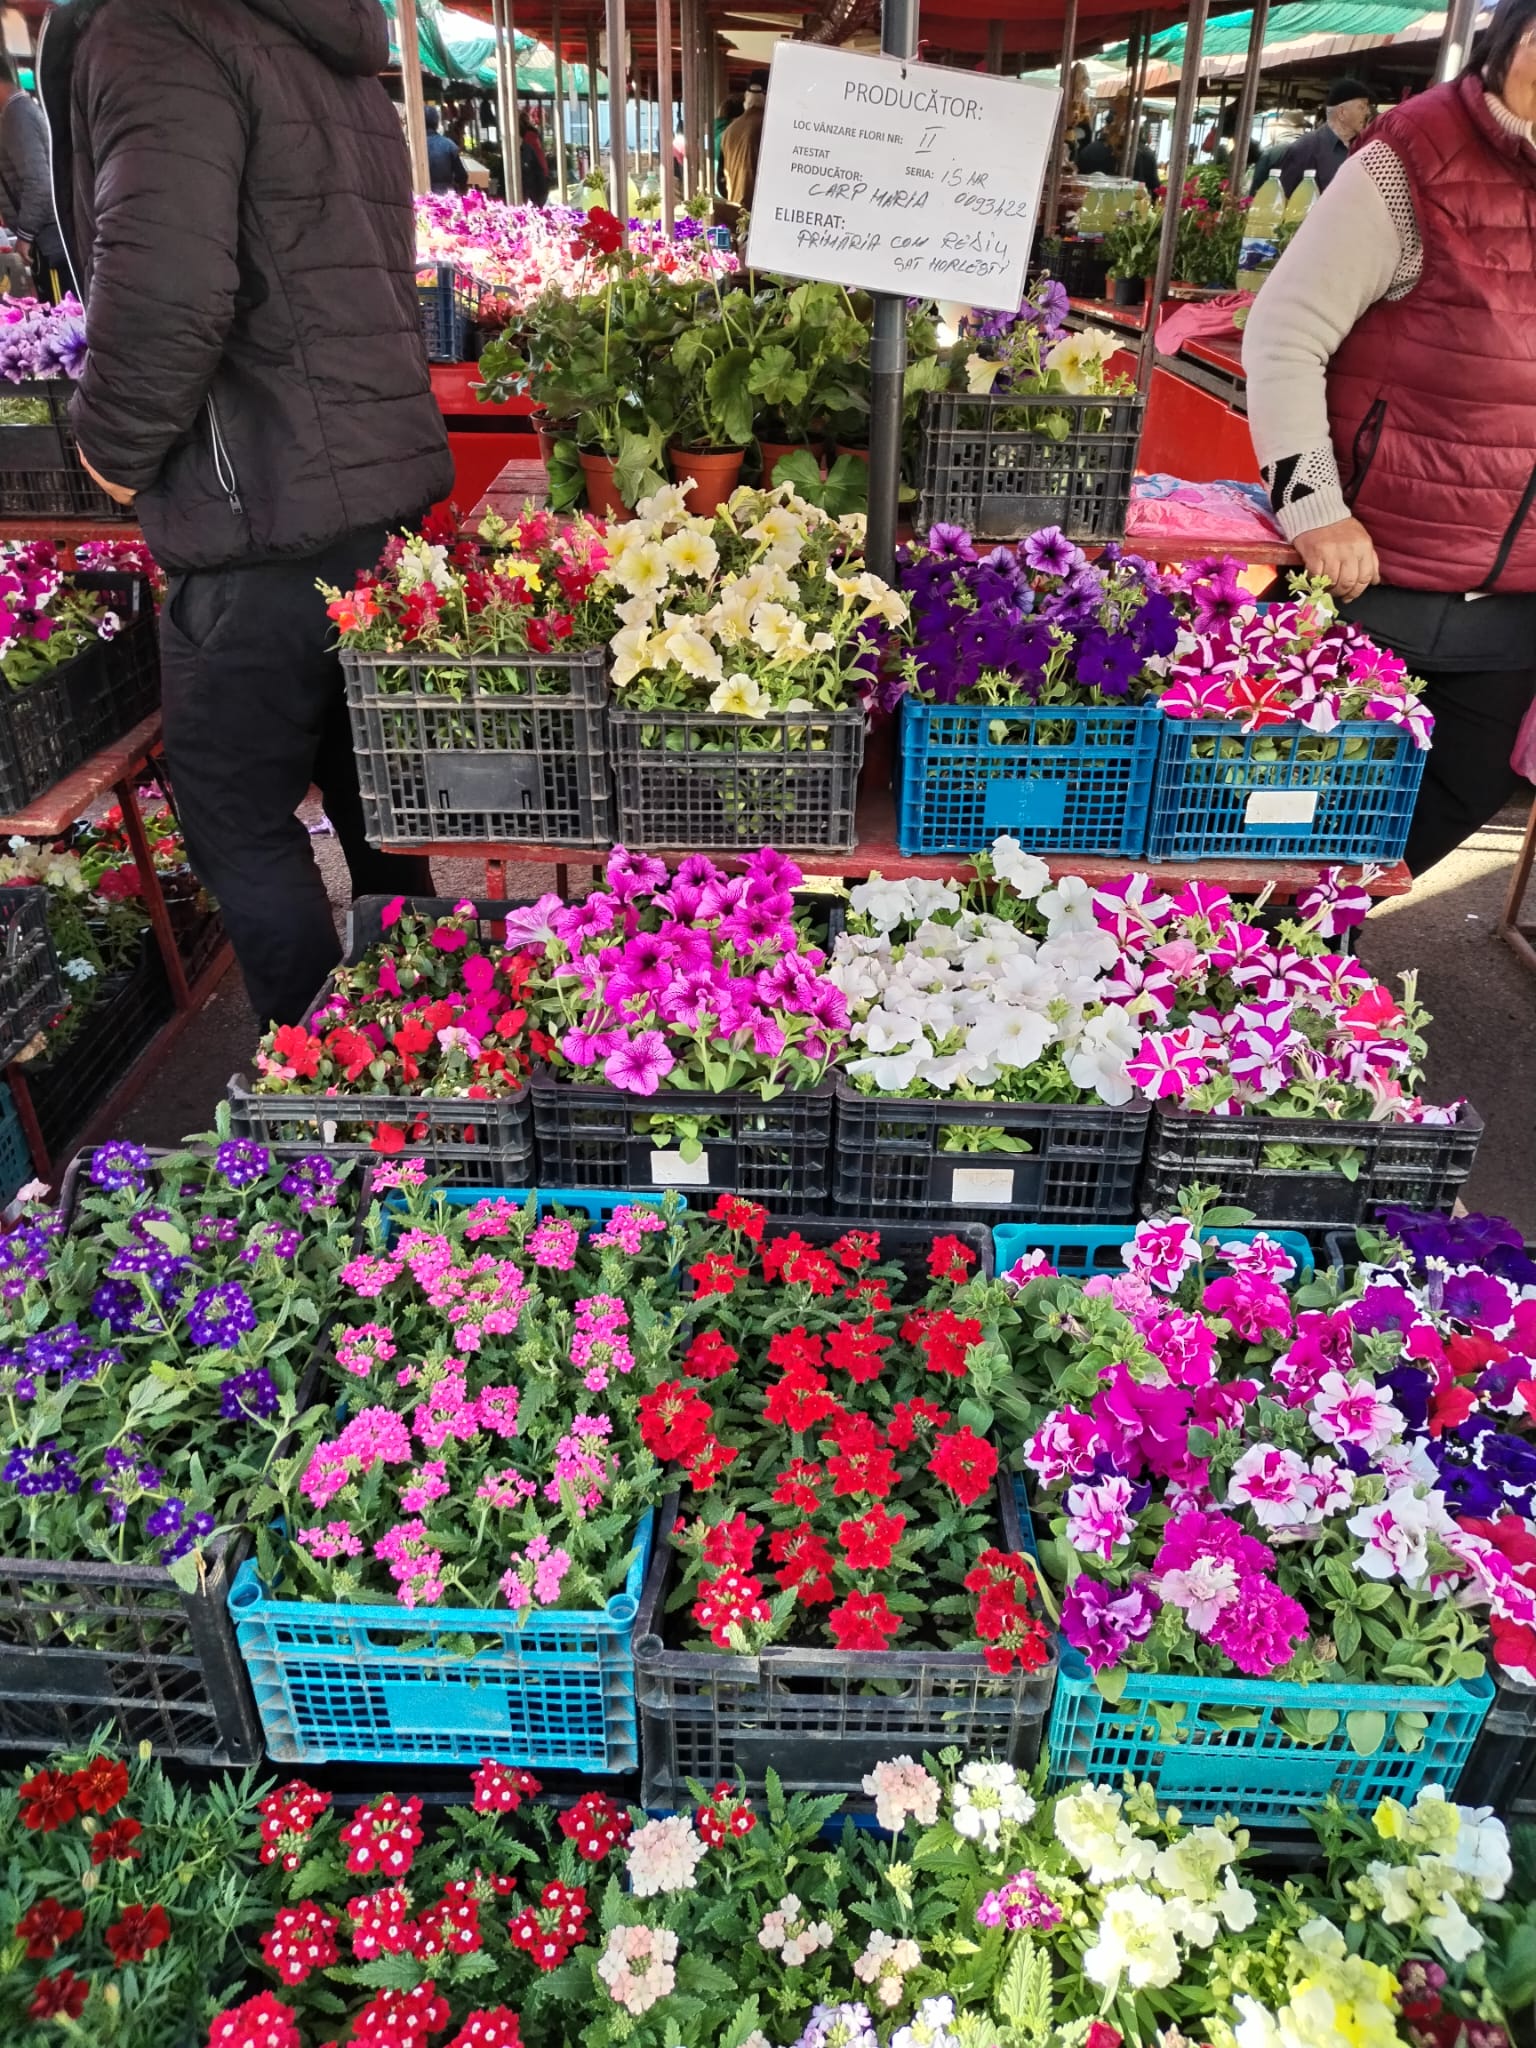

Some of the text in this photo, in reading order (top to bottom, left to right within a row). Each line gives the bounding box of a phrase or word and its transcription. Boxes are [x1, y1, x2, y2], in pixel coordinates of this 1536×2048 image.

[843, 80, 983, 121] PRODUCĂTOR:
[793, 119, 812, 131] LOC
[813, 121, 857, 138] VÂNZARE
[858, 129, 885, 142] FLORI
[887, 133, 904, 145] NR:
[792, 145, 831, 159] ATESTAT
[790, 162, 863, 181] PRODUCĂTOR:
[904, 166, 935, 180] SERIA:
[808, 182, 868, 201] CARP
[869, 187, 930, 209] MARIA
[775, 206, 846, 230] ELIBERAT:
[893, 256, 925, 272] SAT
